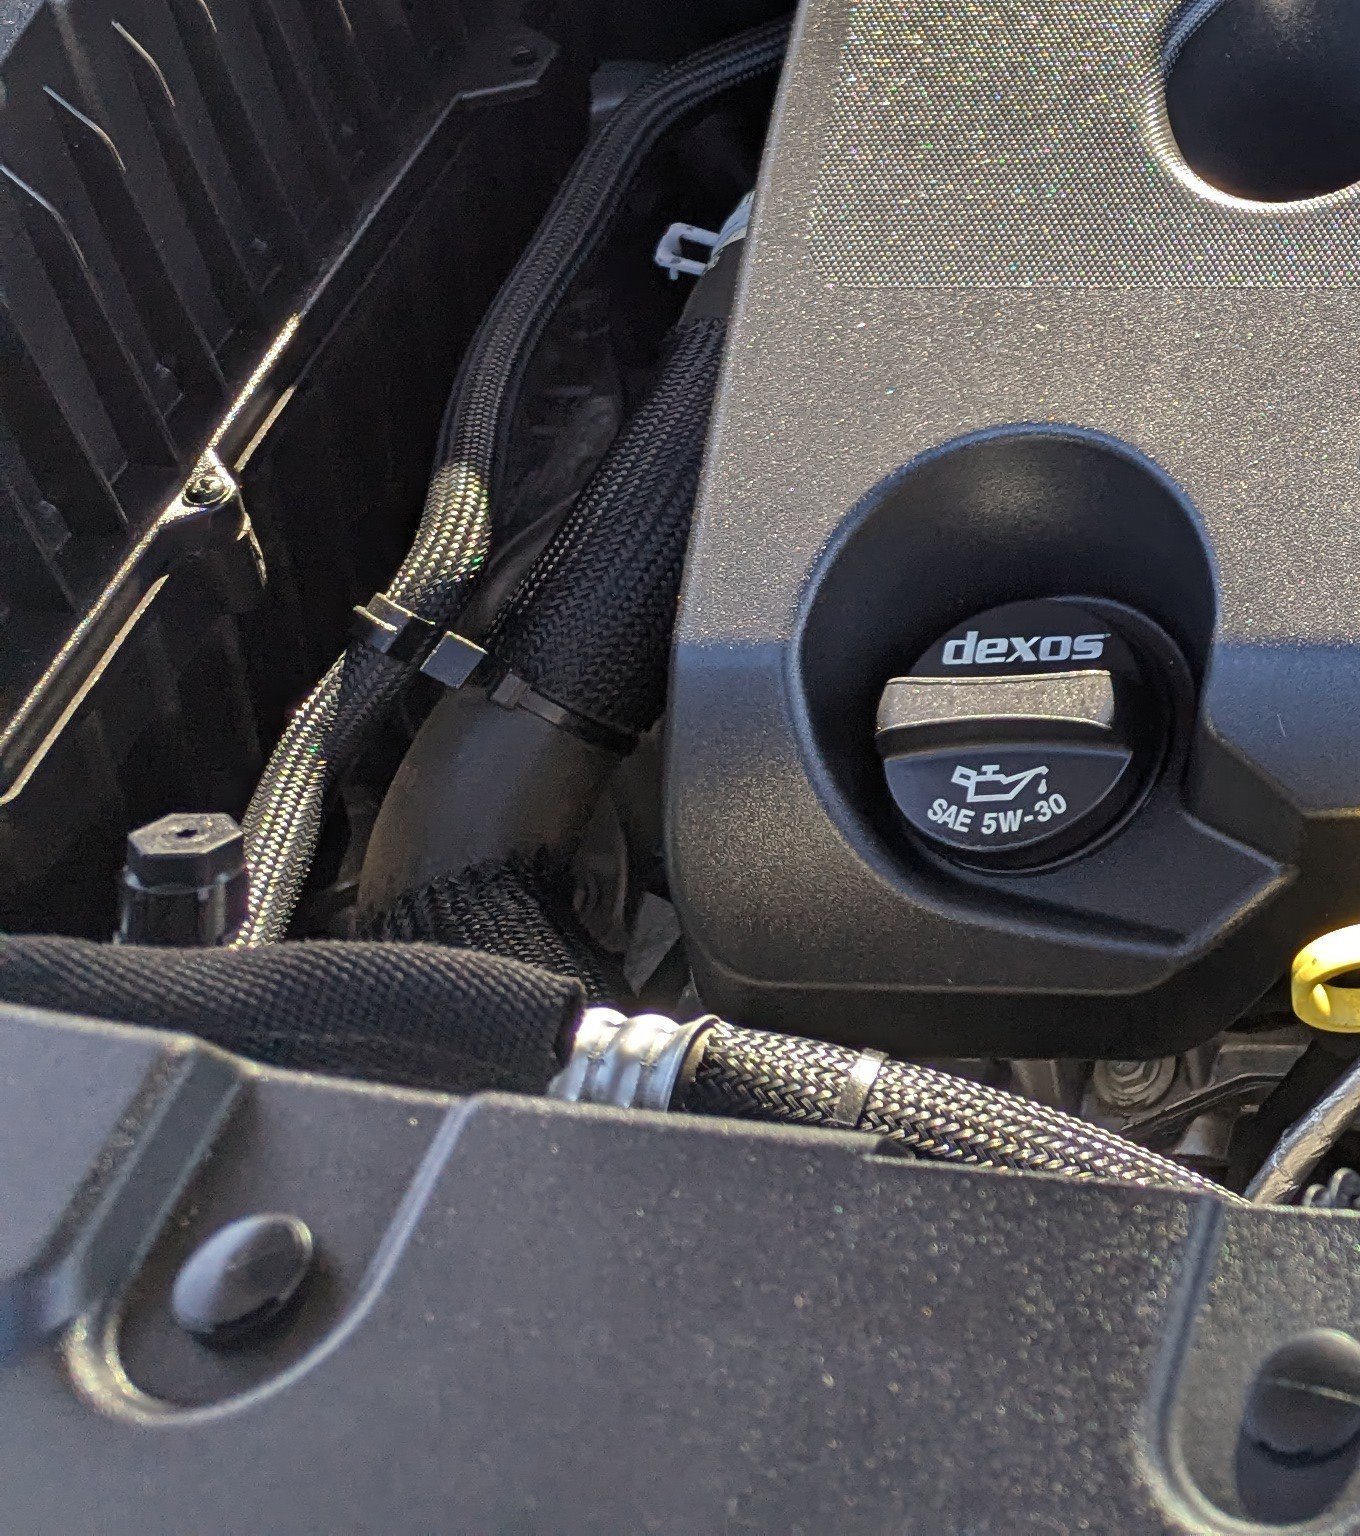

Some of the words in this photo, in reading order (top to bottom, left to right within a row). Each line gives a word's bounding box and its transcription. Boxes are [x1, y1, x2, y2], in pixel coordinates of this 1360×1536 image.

[941, 630, 1104, 665] dexos
[927, 797, 975, 834] SAE
[981, 792, 1068, 835] 5W-30
